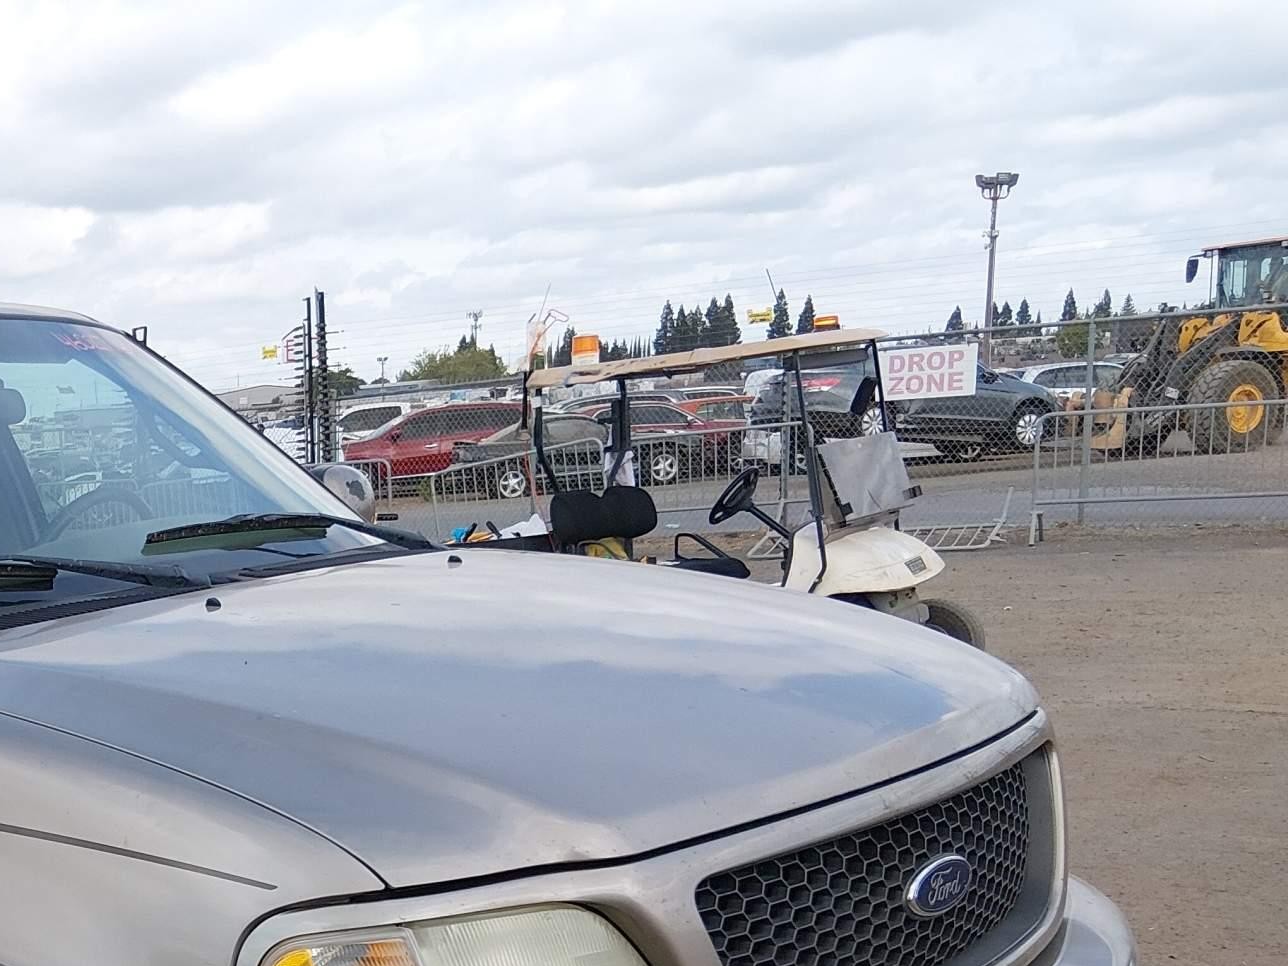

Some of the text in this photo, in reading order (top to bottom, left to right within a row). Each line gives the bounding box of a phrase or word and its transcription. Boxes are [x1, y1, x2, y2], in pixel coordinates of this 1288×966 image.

[888, 350, 965, 374] DROP
[887, 372, 964, 395] ZONE
[927, 866, 962, 905] Ford
